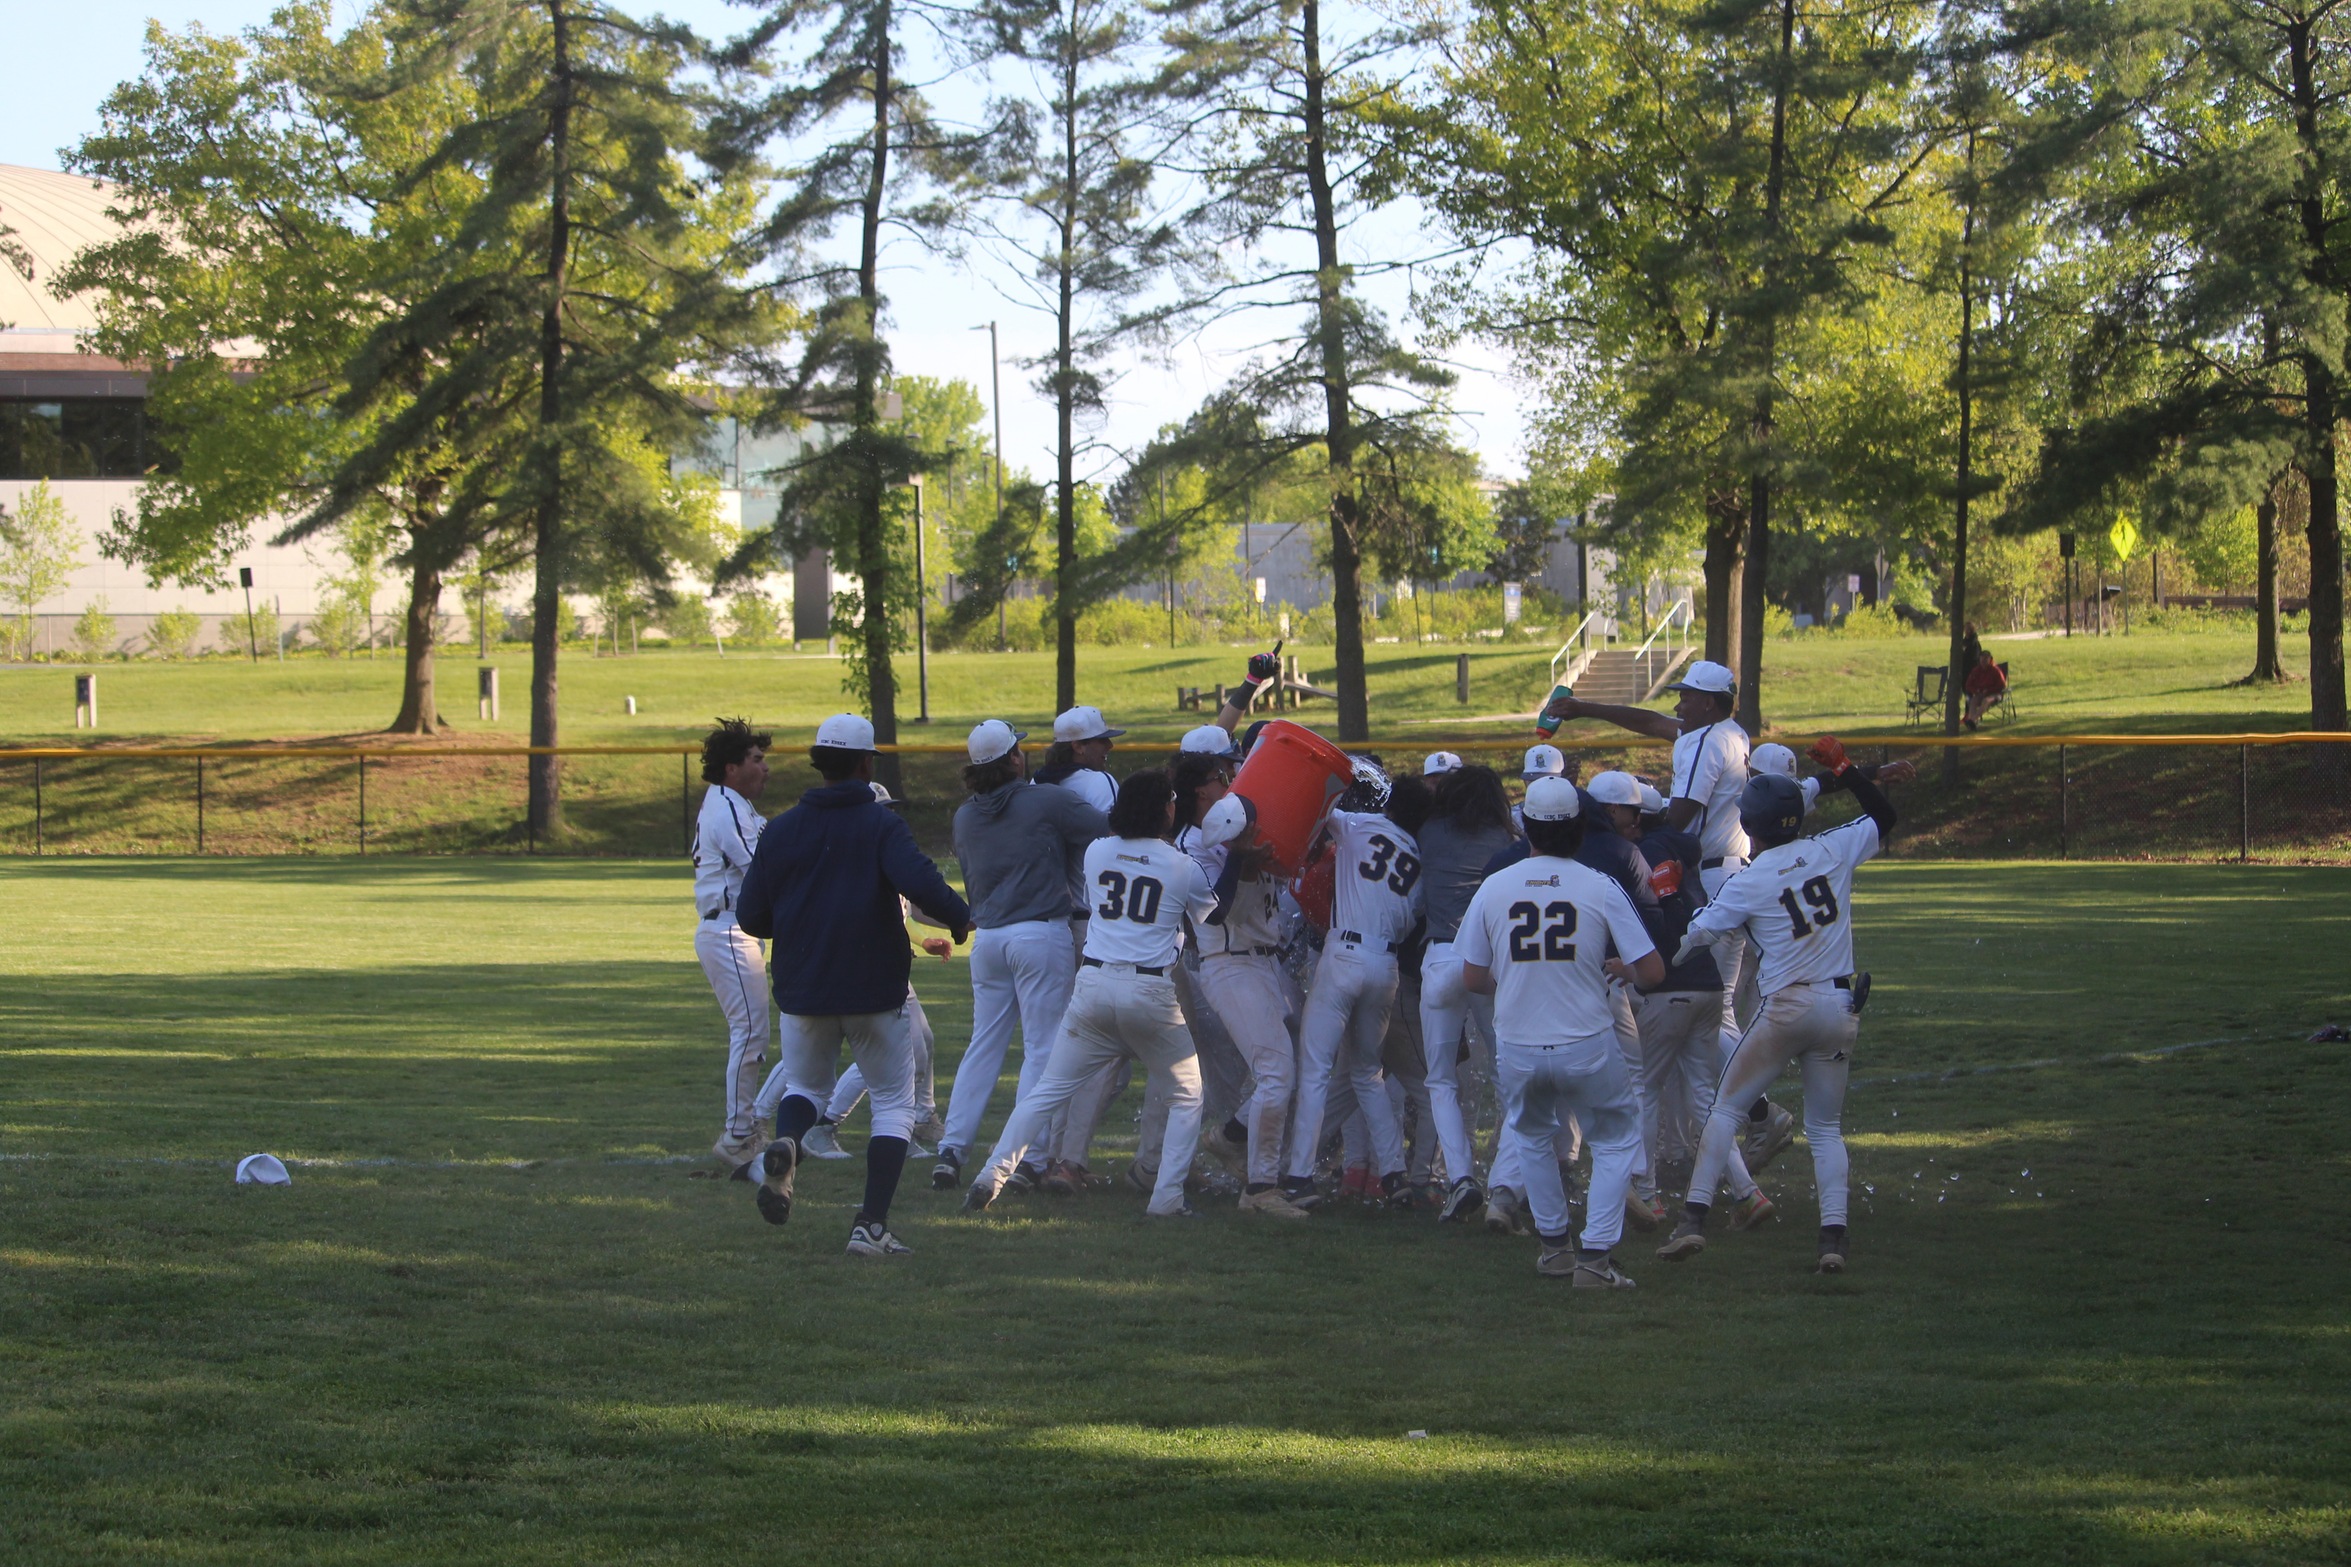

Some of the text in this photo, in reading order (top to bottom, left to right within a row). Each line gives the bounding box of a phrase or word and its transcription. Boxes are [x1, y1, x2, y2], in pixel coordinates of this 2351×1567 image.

[1781, 816, 1797, 828] 19
[1358, 833, 1422, 898] 39
[1098, 869, 1164, 924] 30
[1778, 874, 1839, 941] 19
[1508, 901, 1577, 962] 22
